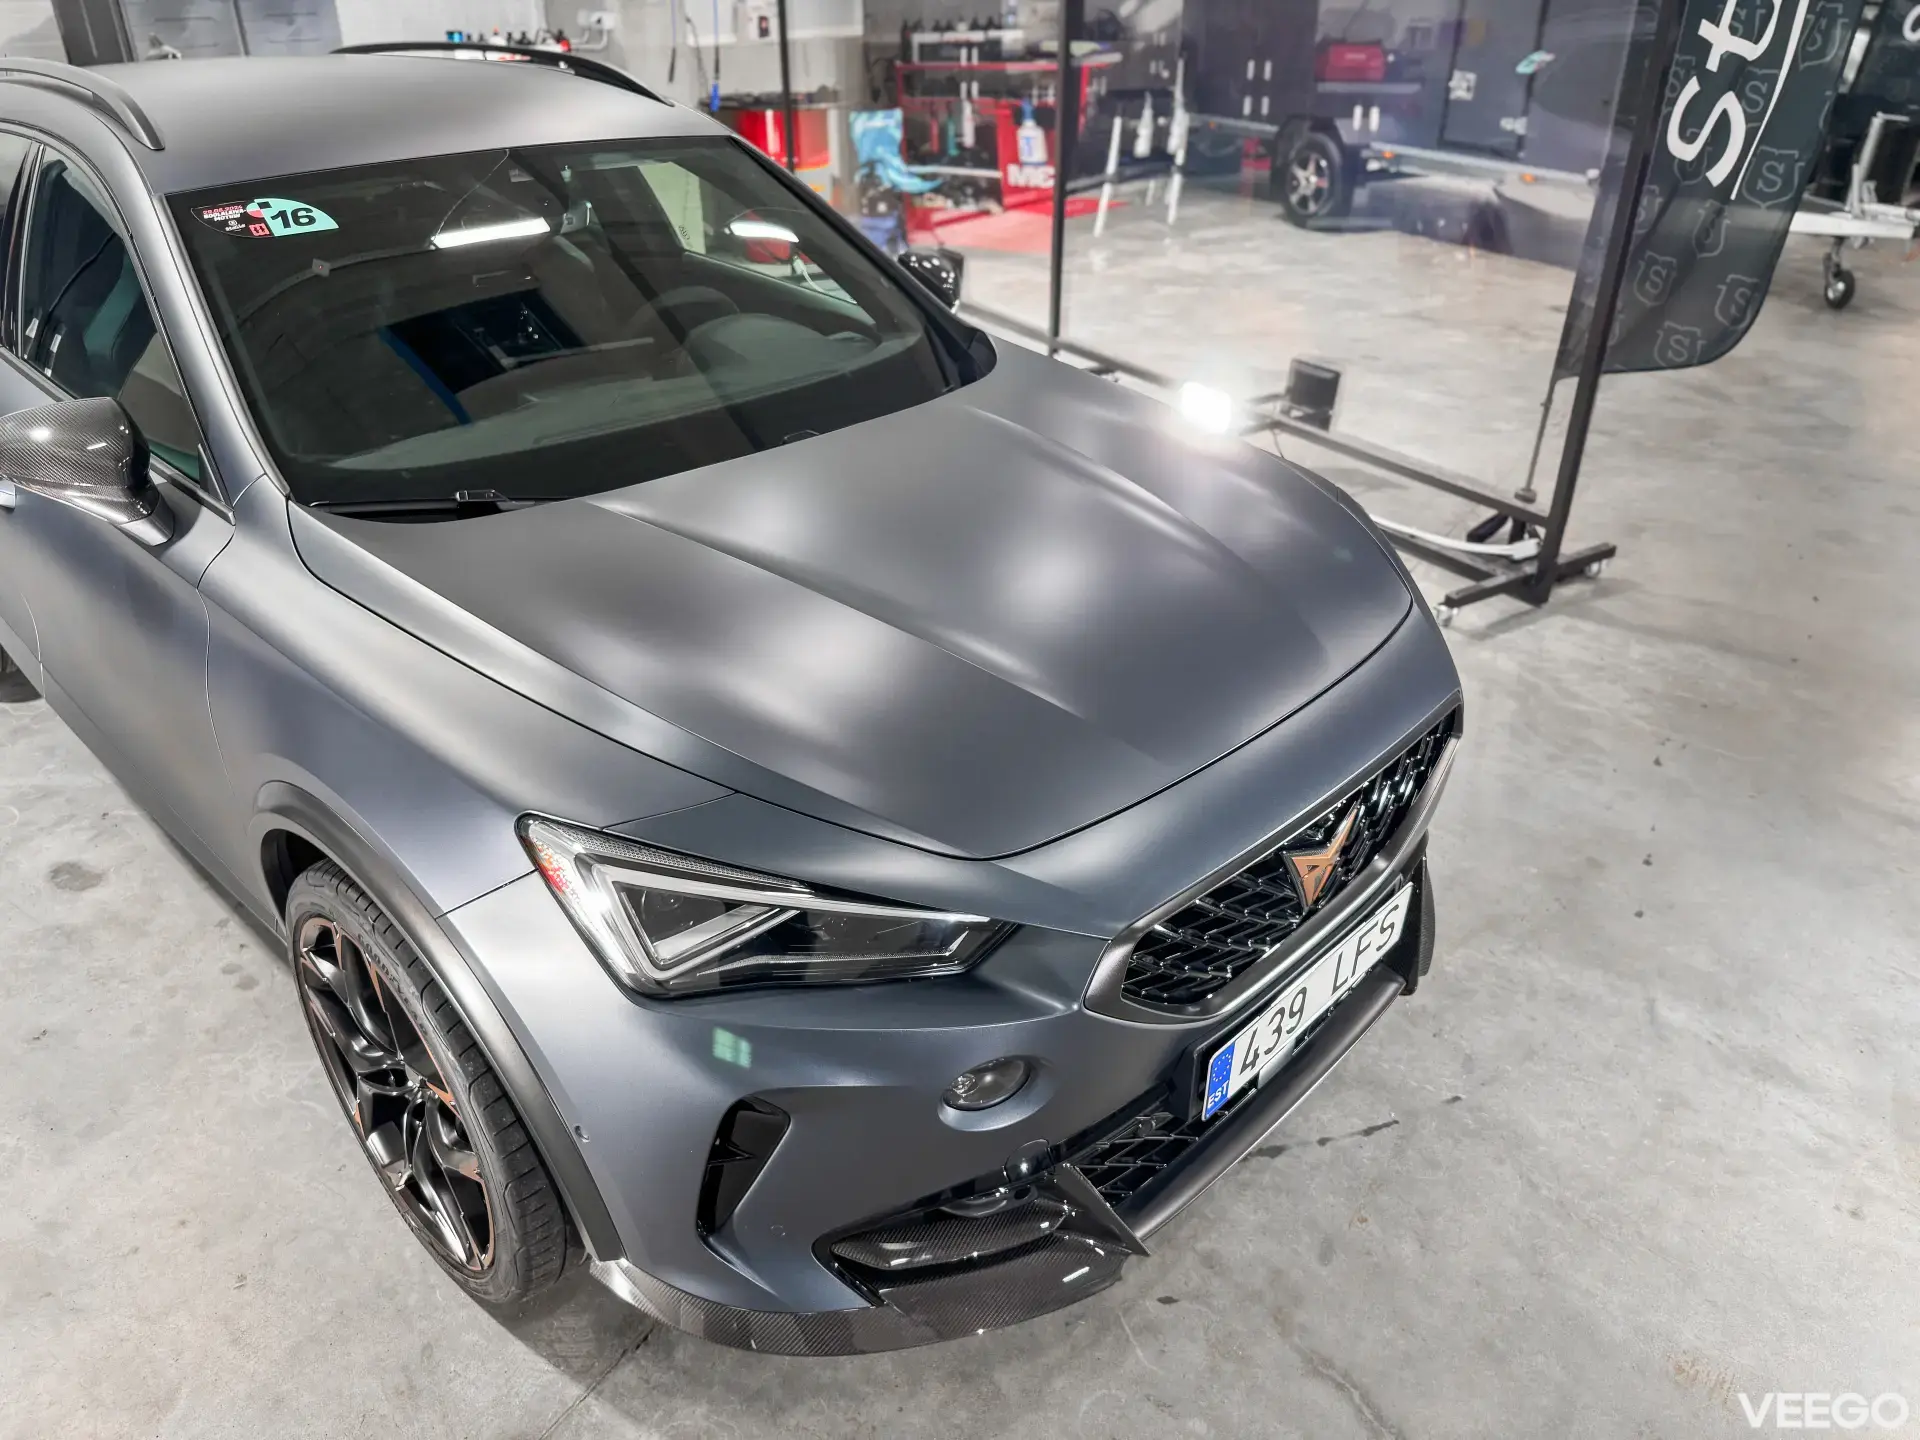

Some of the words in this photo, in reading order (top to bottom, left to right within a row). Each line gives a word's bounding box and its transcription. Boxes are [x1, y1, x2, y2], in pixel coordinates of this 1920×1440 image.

[270, 207, 317, 229] 16
[1239, 986, 1308, 1076] 439
[1331, 904, 1400, 996] LFS
[1208, 1080, 1229, 1109] EST
